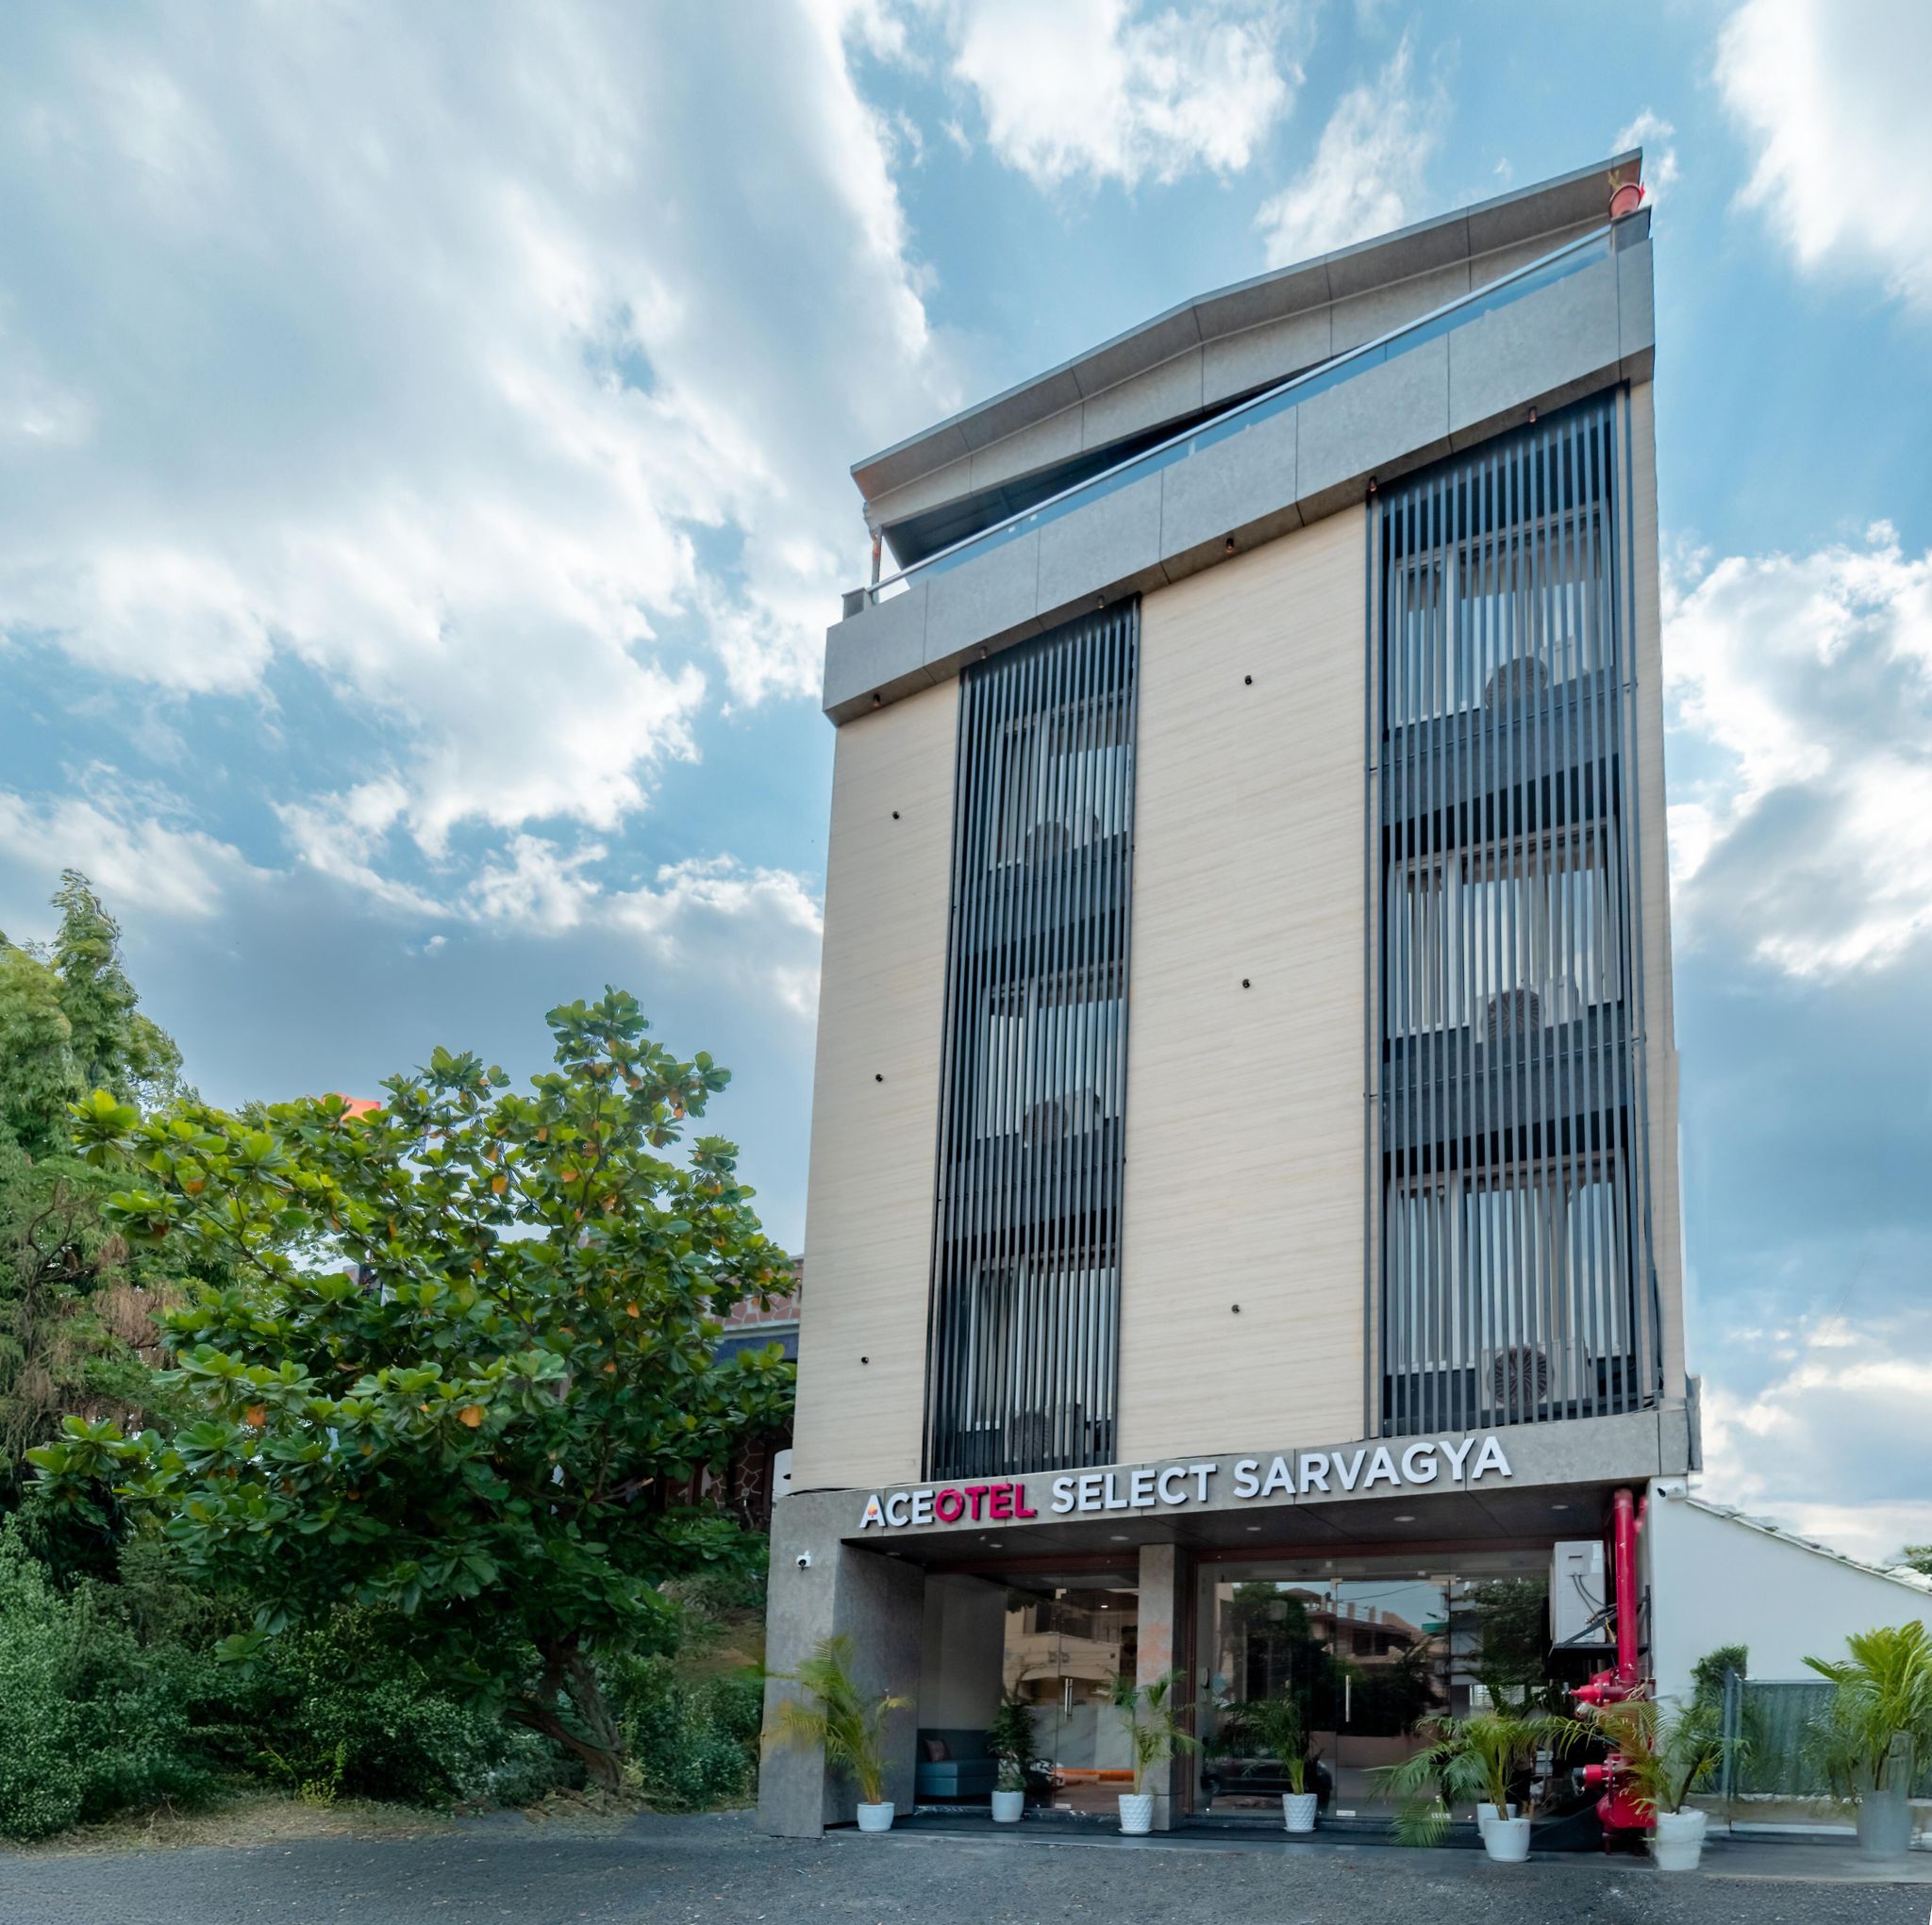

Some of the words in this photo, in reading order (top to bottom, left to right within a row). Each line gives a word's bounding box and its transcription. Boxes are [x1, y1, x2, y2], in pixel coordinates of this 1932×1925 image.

[859, 1483, 1037, 1529] ACEOTEL
[1052, 1463, 1218, 1514] SELECT
[1234, 1435, 1512, 1499] SARVAGYA
